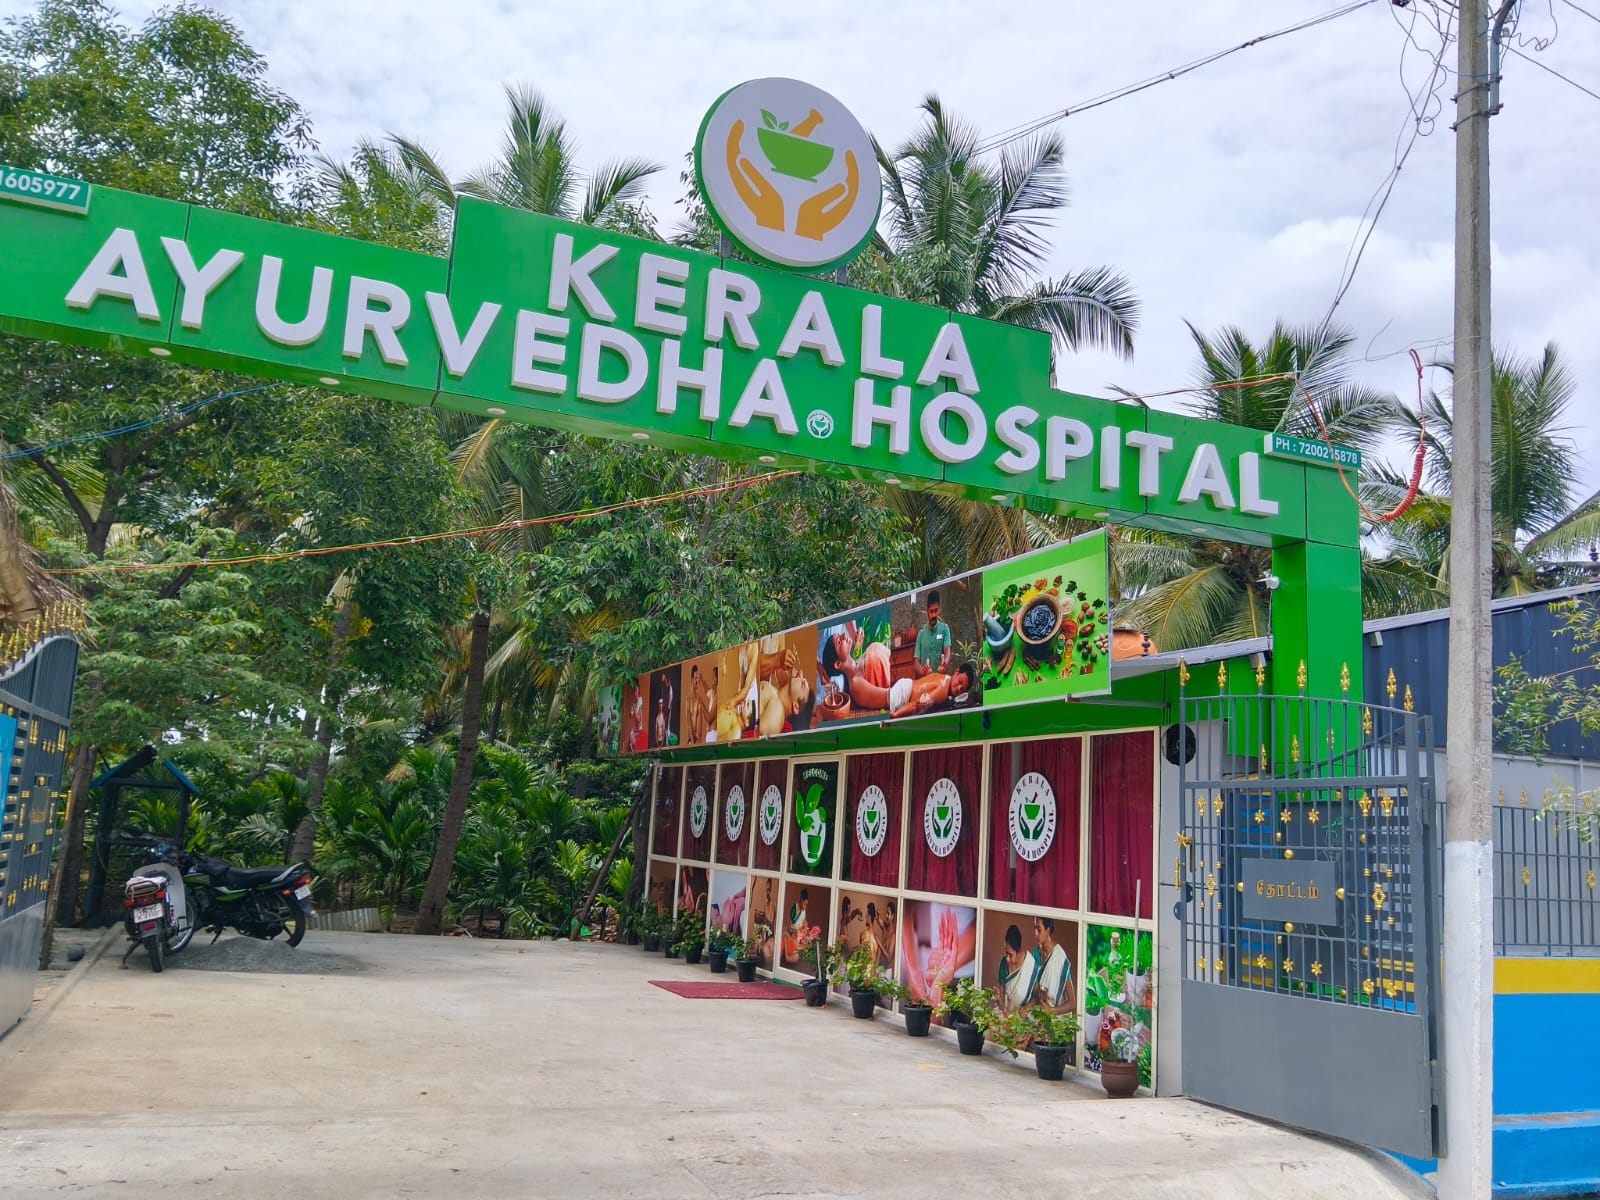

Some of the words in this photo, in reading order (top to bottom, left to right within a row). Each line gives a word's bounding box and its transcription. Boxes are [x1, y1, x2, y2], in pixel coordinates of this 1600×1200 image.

[547, 233, 981, 395] KERALA
[65, 227, 799, 436] AYURVEDHA
[851, 377, 1280, 517] HOSPITAL
[1275, 437, 1290, 451] PH
[1016, 775, 1050, 797] KERALA
[1256, 879, 1319, 900] தோட்டம்
